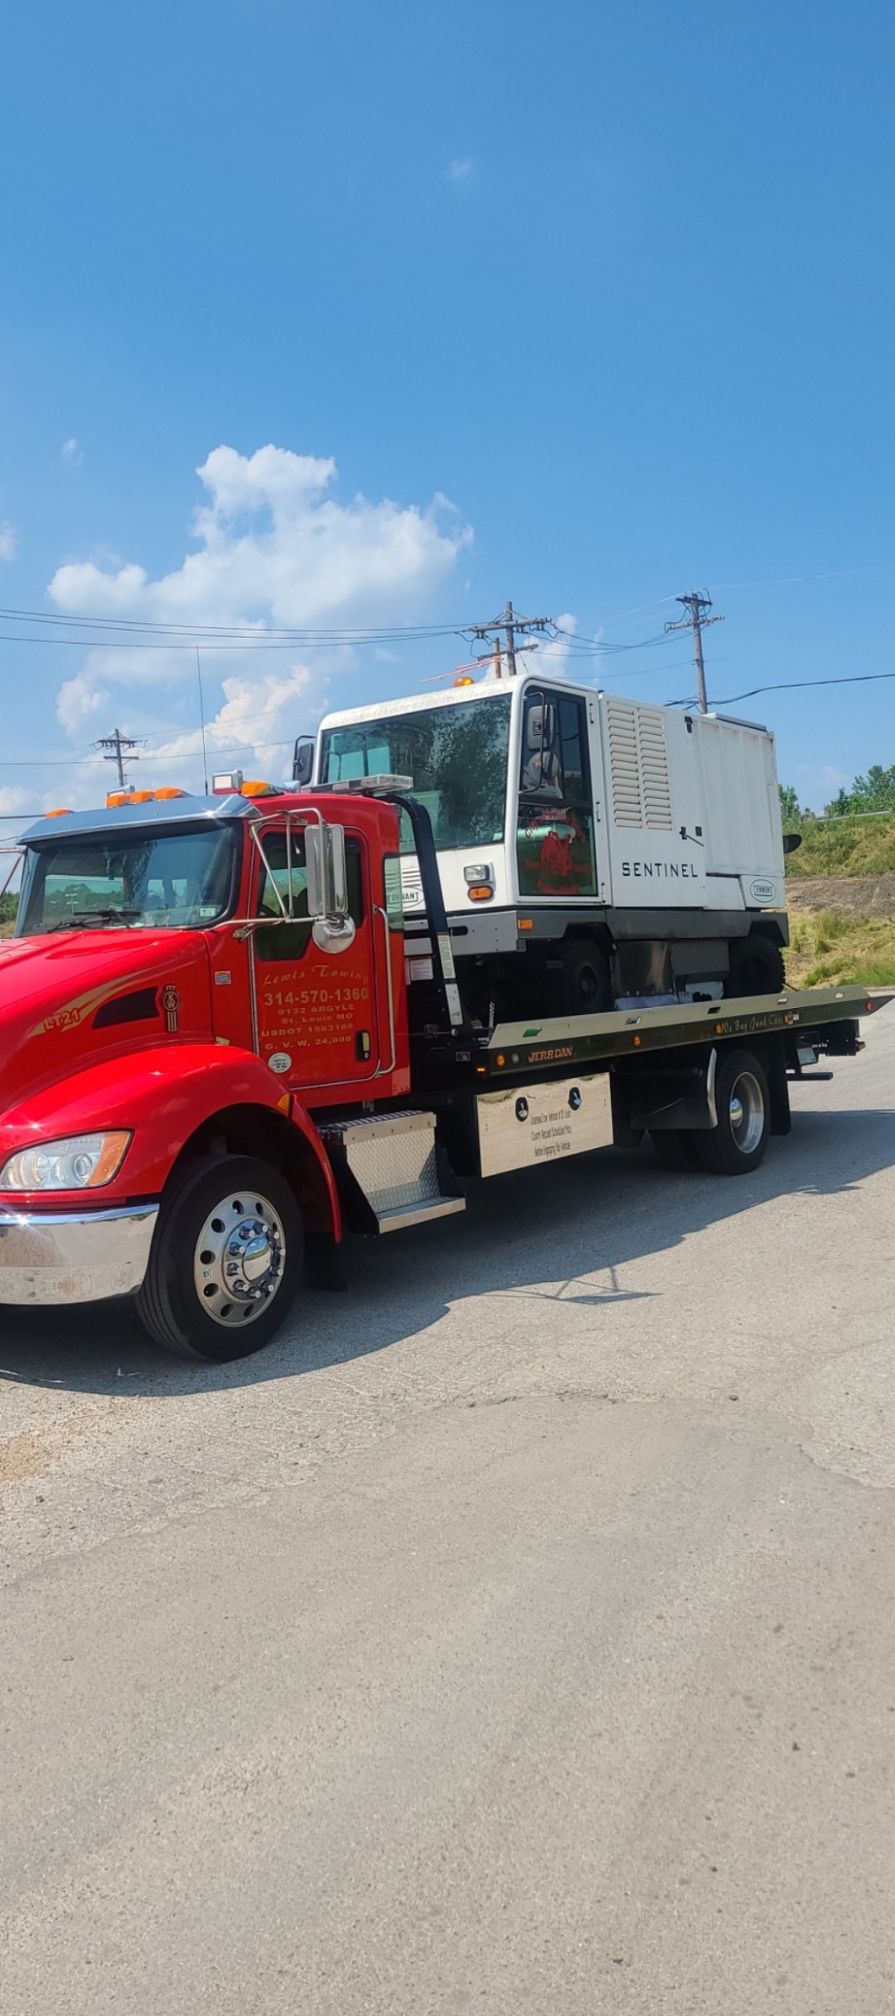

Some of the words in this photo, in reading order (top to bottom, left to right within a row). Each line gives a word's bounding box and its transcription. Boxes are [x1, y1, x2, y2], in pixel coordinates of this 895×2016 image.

[621, 861, 699, 878] SENTINEL
[263, 970, 306, 987] Lewis
[311, 964, 369, 985] Towing
[263, 987, 369, 1007] 314-570-1360
[310, 1003, 356, 1013] ARGYLE
[301, 1014, 333, 1023] Louis
[336, 1012, 353, 1021] MO
[261, 1026, 302, 1038] USDOT
[315, 1035, 352, 1047] 24,000
